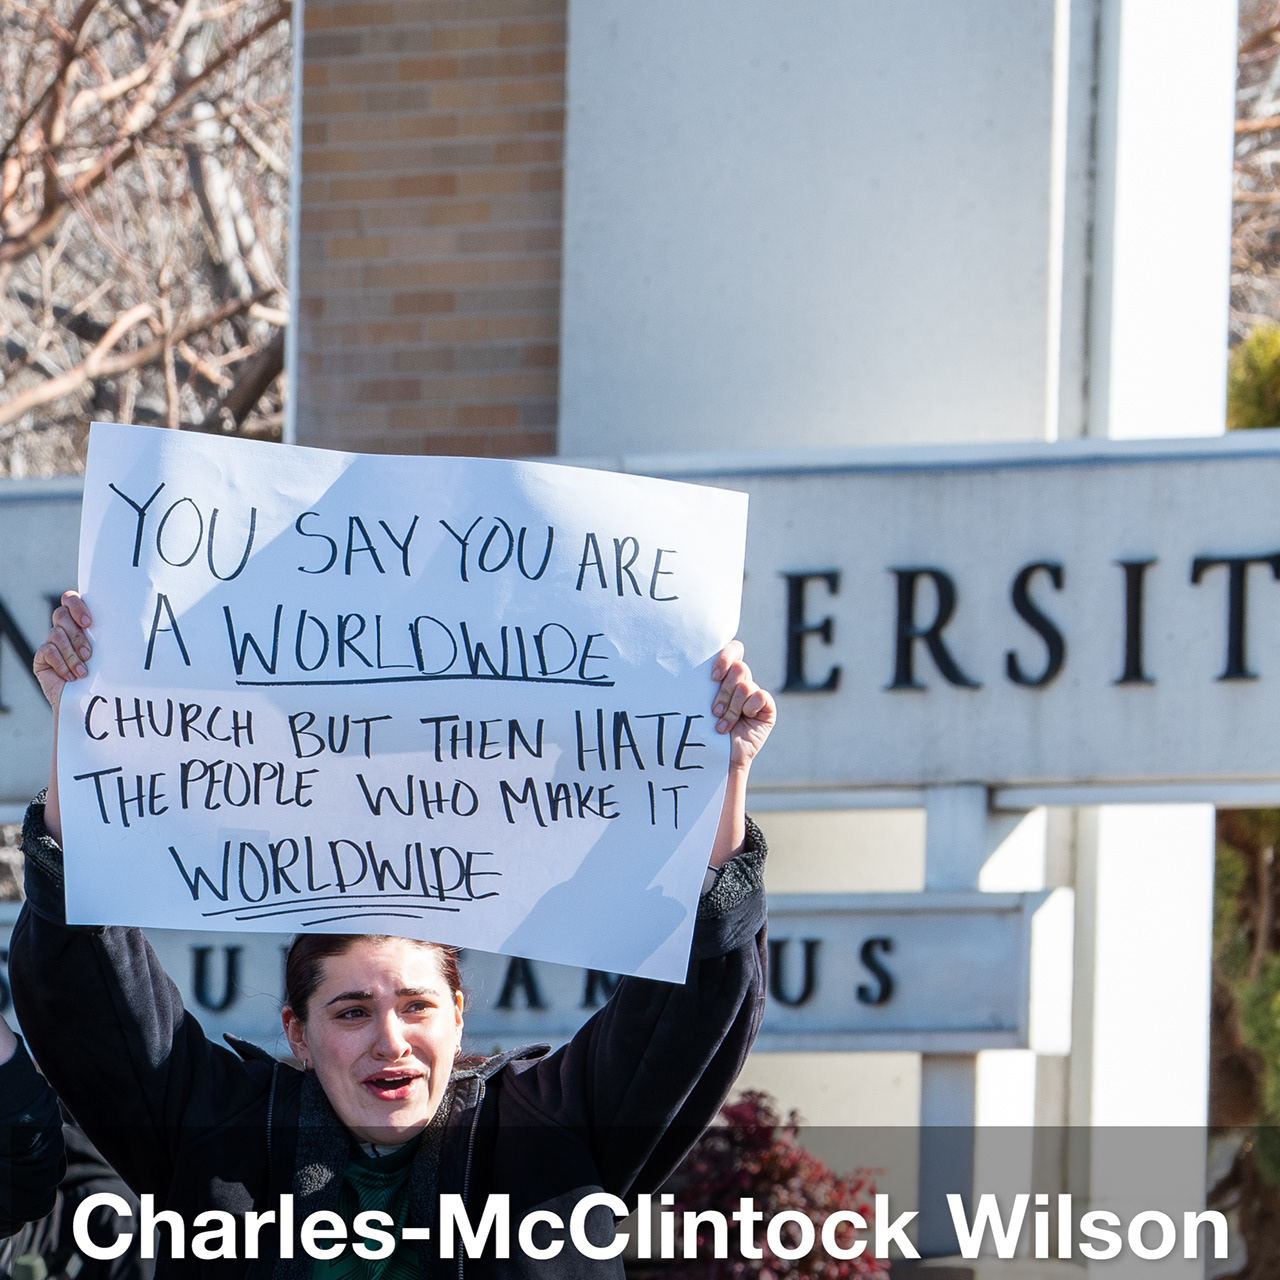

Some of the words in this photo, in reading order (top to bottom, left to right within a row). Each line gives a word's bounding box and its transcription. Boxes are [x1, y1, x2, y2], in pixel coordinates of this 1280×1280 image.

[108, 482, 257, 582] YOU
[294, 511, 420, 577] SAY
[439, 514, 554, 583] YOU
[575, 531, 681, 602] ARE
[143, 592, 192, 671] A
[223, 602, 615, 683] WORLDWIDE
[83, 694, 255, 748] CHURCH
[287, 711, 393, 760] BUT
[419, 714, 545, 763] THEN
[573, 707, 707, 772] HATE
[73, 764, 169, 829] THE
[178, 757, 320, 811] PEOPLE
[355, 772, 480, 821] WHO
[499, 775, 622, 828] MAKE
[649, 783, 690, 831] IT
[167, 835, 504, 904] WORLDWIDE
